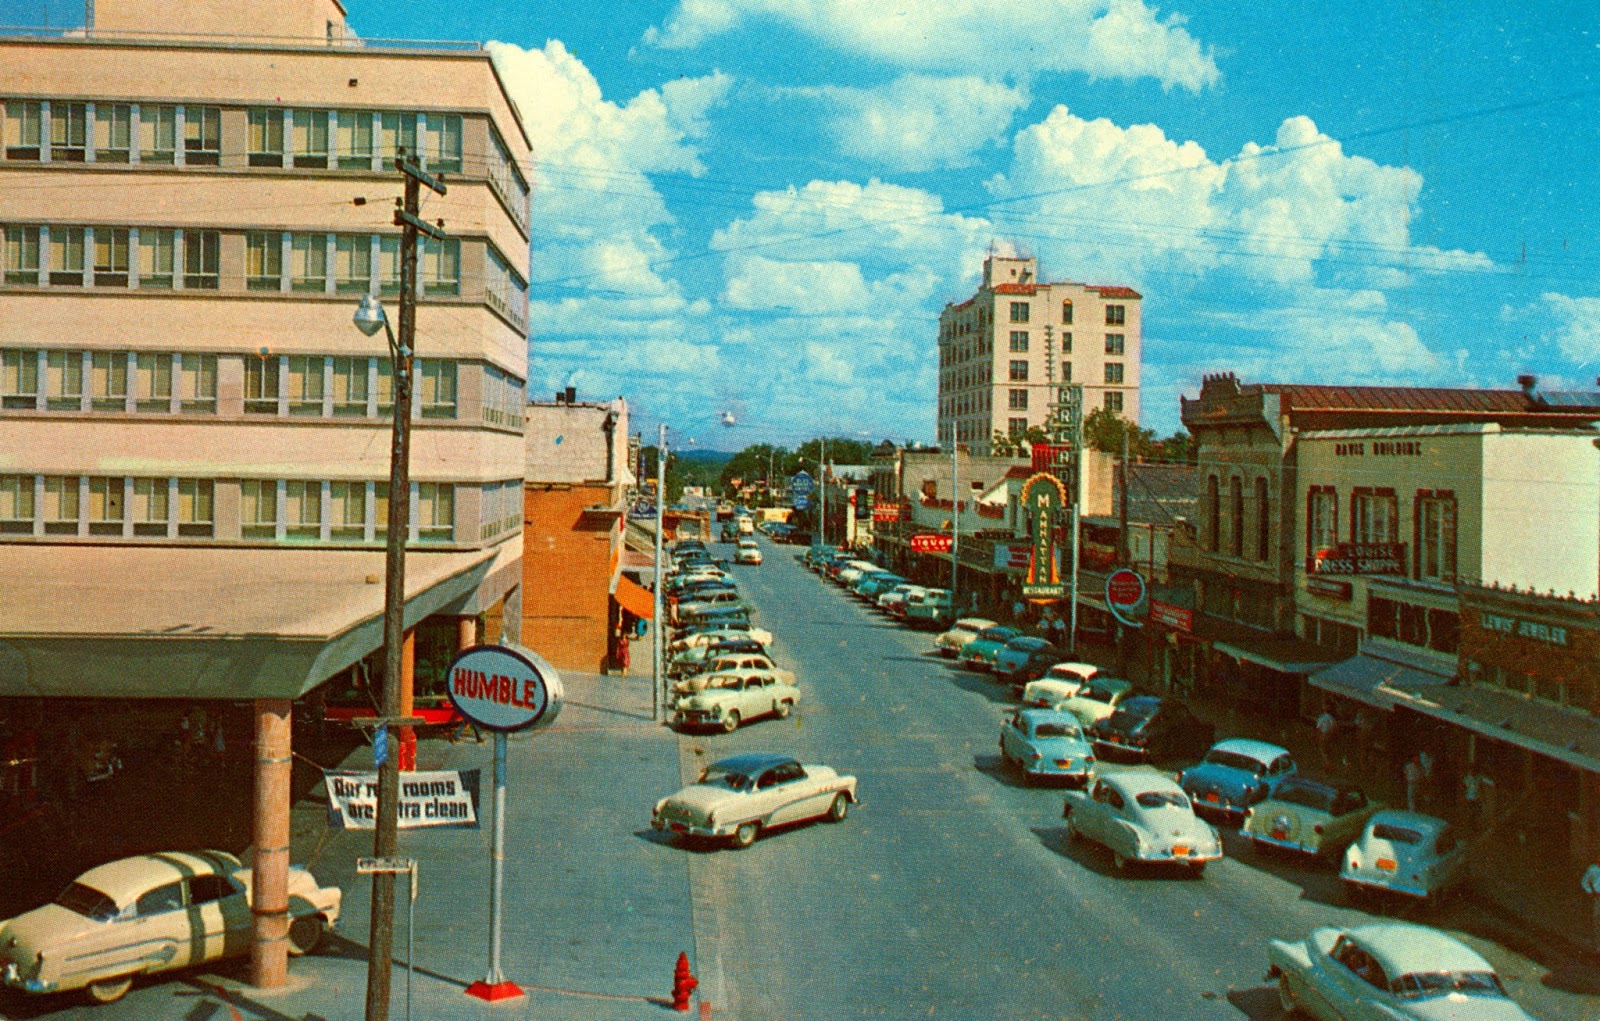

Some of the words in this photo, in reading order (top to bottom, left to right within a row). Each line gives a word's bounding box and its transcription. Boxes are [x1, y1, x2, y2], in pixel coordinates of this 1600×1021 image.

[1372, 441, 1422, 456] BUILDING
[1038, 494, 1050, 583] MANHATTAN
[1314, 558, 1354, 573] DRESS
[1357, 559, 1401, 573] SHOPPE
[1481, 612, 1515, 633] LEWIS
[453, 667, 536, 710] HUMBLE
[334, 777, 360, 797] Our
[403, 780, 455, 797] rooms
[348, 802, 374, 819] are
[397, 800, 420, 818] tra
[425, 797, 468, 818] clean
